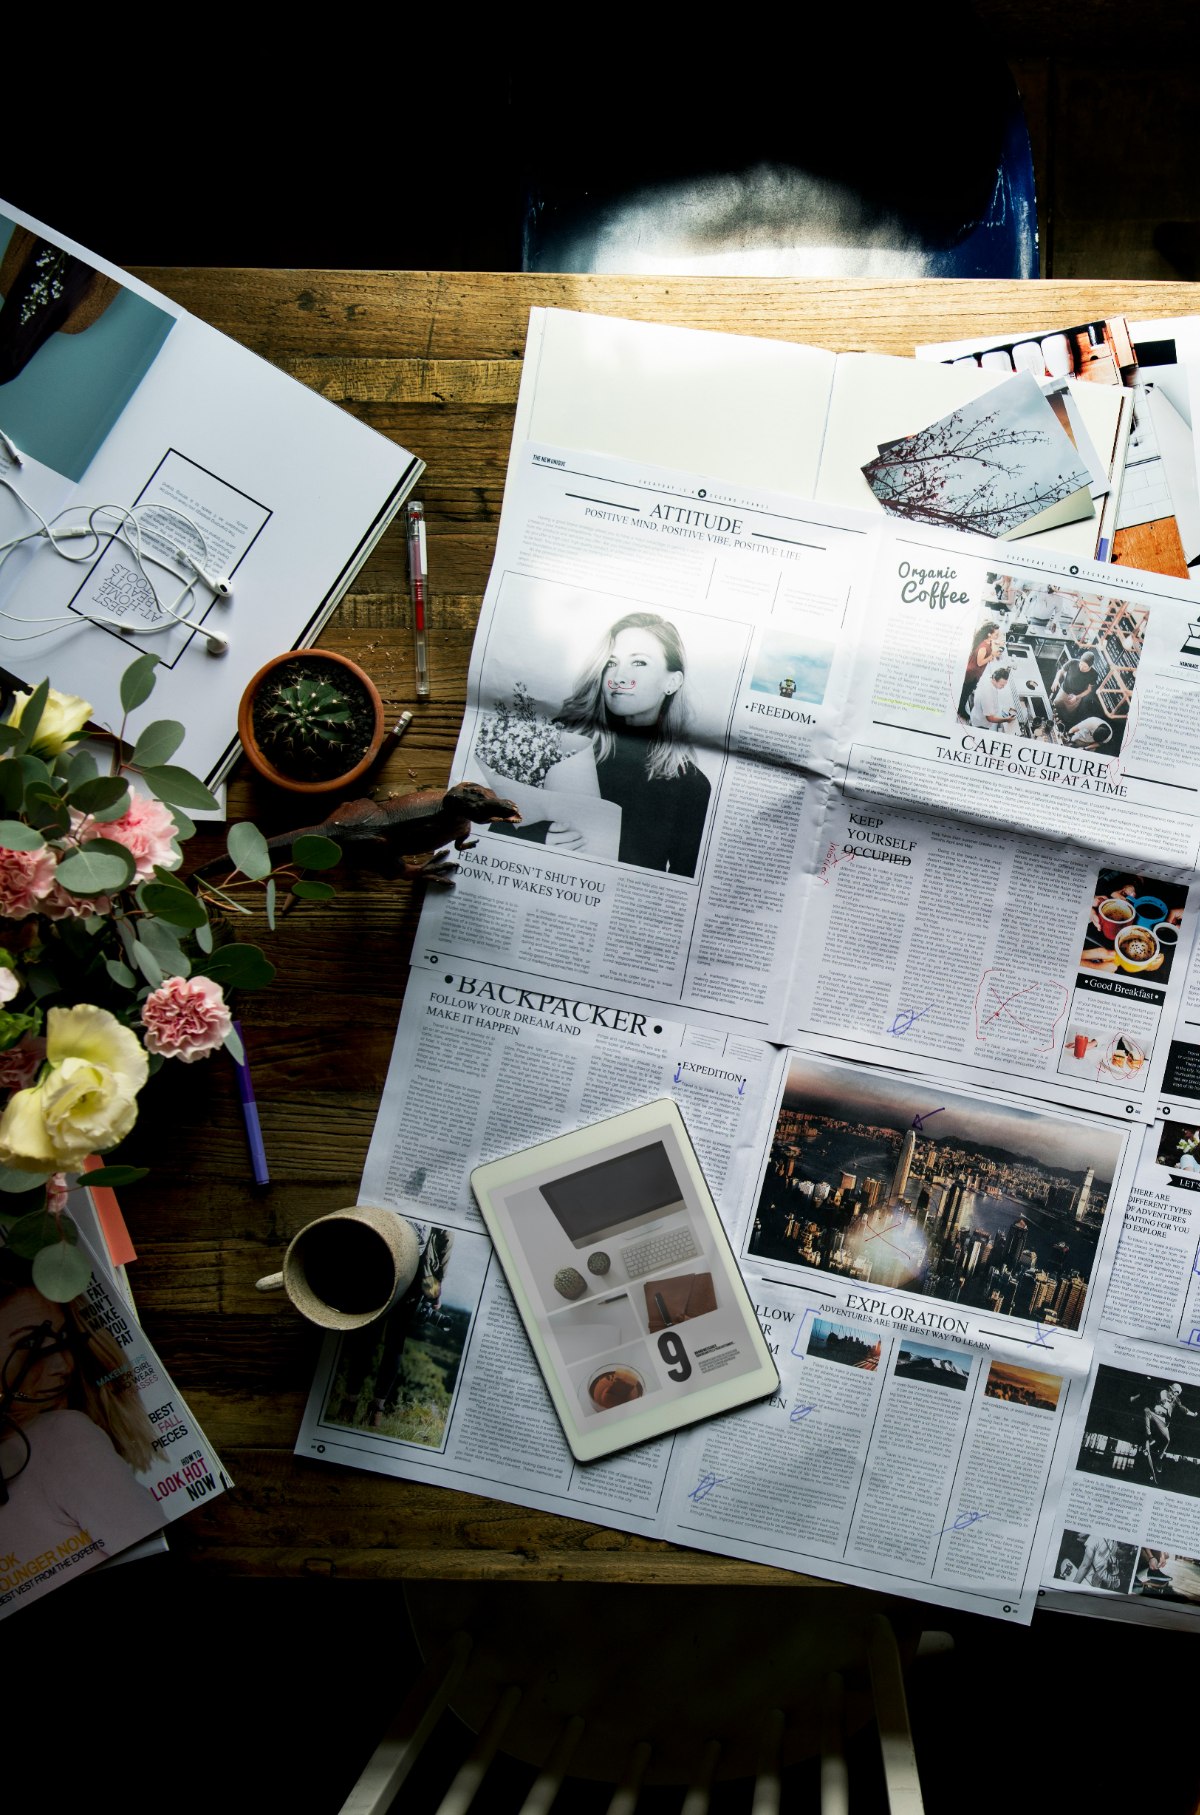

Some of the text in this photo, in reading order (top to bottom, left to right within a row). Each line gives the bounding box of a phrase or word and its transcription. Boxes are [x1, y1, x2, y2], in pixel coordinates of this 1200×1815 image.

[649, 503, 743, 534] ATTITUDE
[584, 507, 801, 560] POSITIVE MIND, POSITIVE VIBE, POSITIVE LIFE
[112, 563, 153, 595] TOOLS
[898, 561, 958, 582] Organic
[99, 582, 162, 622] AT-HOME
[104, 573, 156, 608] BEAUTY
[901, 580, 970, 610] Coffee
[92, 593, 127, 616] BEST
[750, 702, 812, 724] FREEDOM
[961, 734, 1110, 779] CAFE CULTURE
[936, 746, 1127, 797] TAKE LIFE ONE SIP AT A TIME
[848, 812, 884, 828] KEEP
[847, 828, 917, 851] YOURSELF
[841, 844, 911, 866] OCCUPIED
[458, 850, 605, 893] FEAR DOESN'T SHUT YOU
[455, 864, 601, 907] DOWN, IT WAKES YOU UP
[1089, 978, 1154, 999] Good Breakfast
[429, 992, 581, 1036] FOLLOW YOUR DREAM AND
[458, 976, 648, 1037] BACKPACKER
[426, 1005, 520, 1036] MAKE IT HAPPEN
[682, 1062, 742, 1083] EXPEDITION
[1128, 1196, 1192, 1216] DIFFERENT TYPES
[1154, 1193, 1170, 1202] ARE
[1124, 1213, 1190, 1234] WAITING FOR YOU
[1126, 1204, 1186, 1224] OF ADVENTURES
[1122, 1222, 1166, 1238] TO EXPLORE
[87, 1284, 105, 1301] FAT
[81, 1295, 112, 1319] WON'T
[89, 1307, 120, 1331] MAKE
[846, 1294, 969, 1334] EXPLORATION
[106, 1319, 127, 1337] YOU
[115, 1330, 133, 1348] FAT
[819, 1304, 991, 1350] ADVENTURES ARE THE BEST WAY TO LEARN
[657, 1331, 692, 1382] 9
[148, 1402, 175, 1424] BEST
[158, 1414, 183, 1433] FALL
[151, 1425, 188, 1452] PIECES
[181, 1450, 202, 1466] HOW TO
[150, 1458, 208, 1502] LOOK HOT
[186, 1473, 216, 1501] NOW
[71, 1539, 105, 1562] EXPERTS
